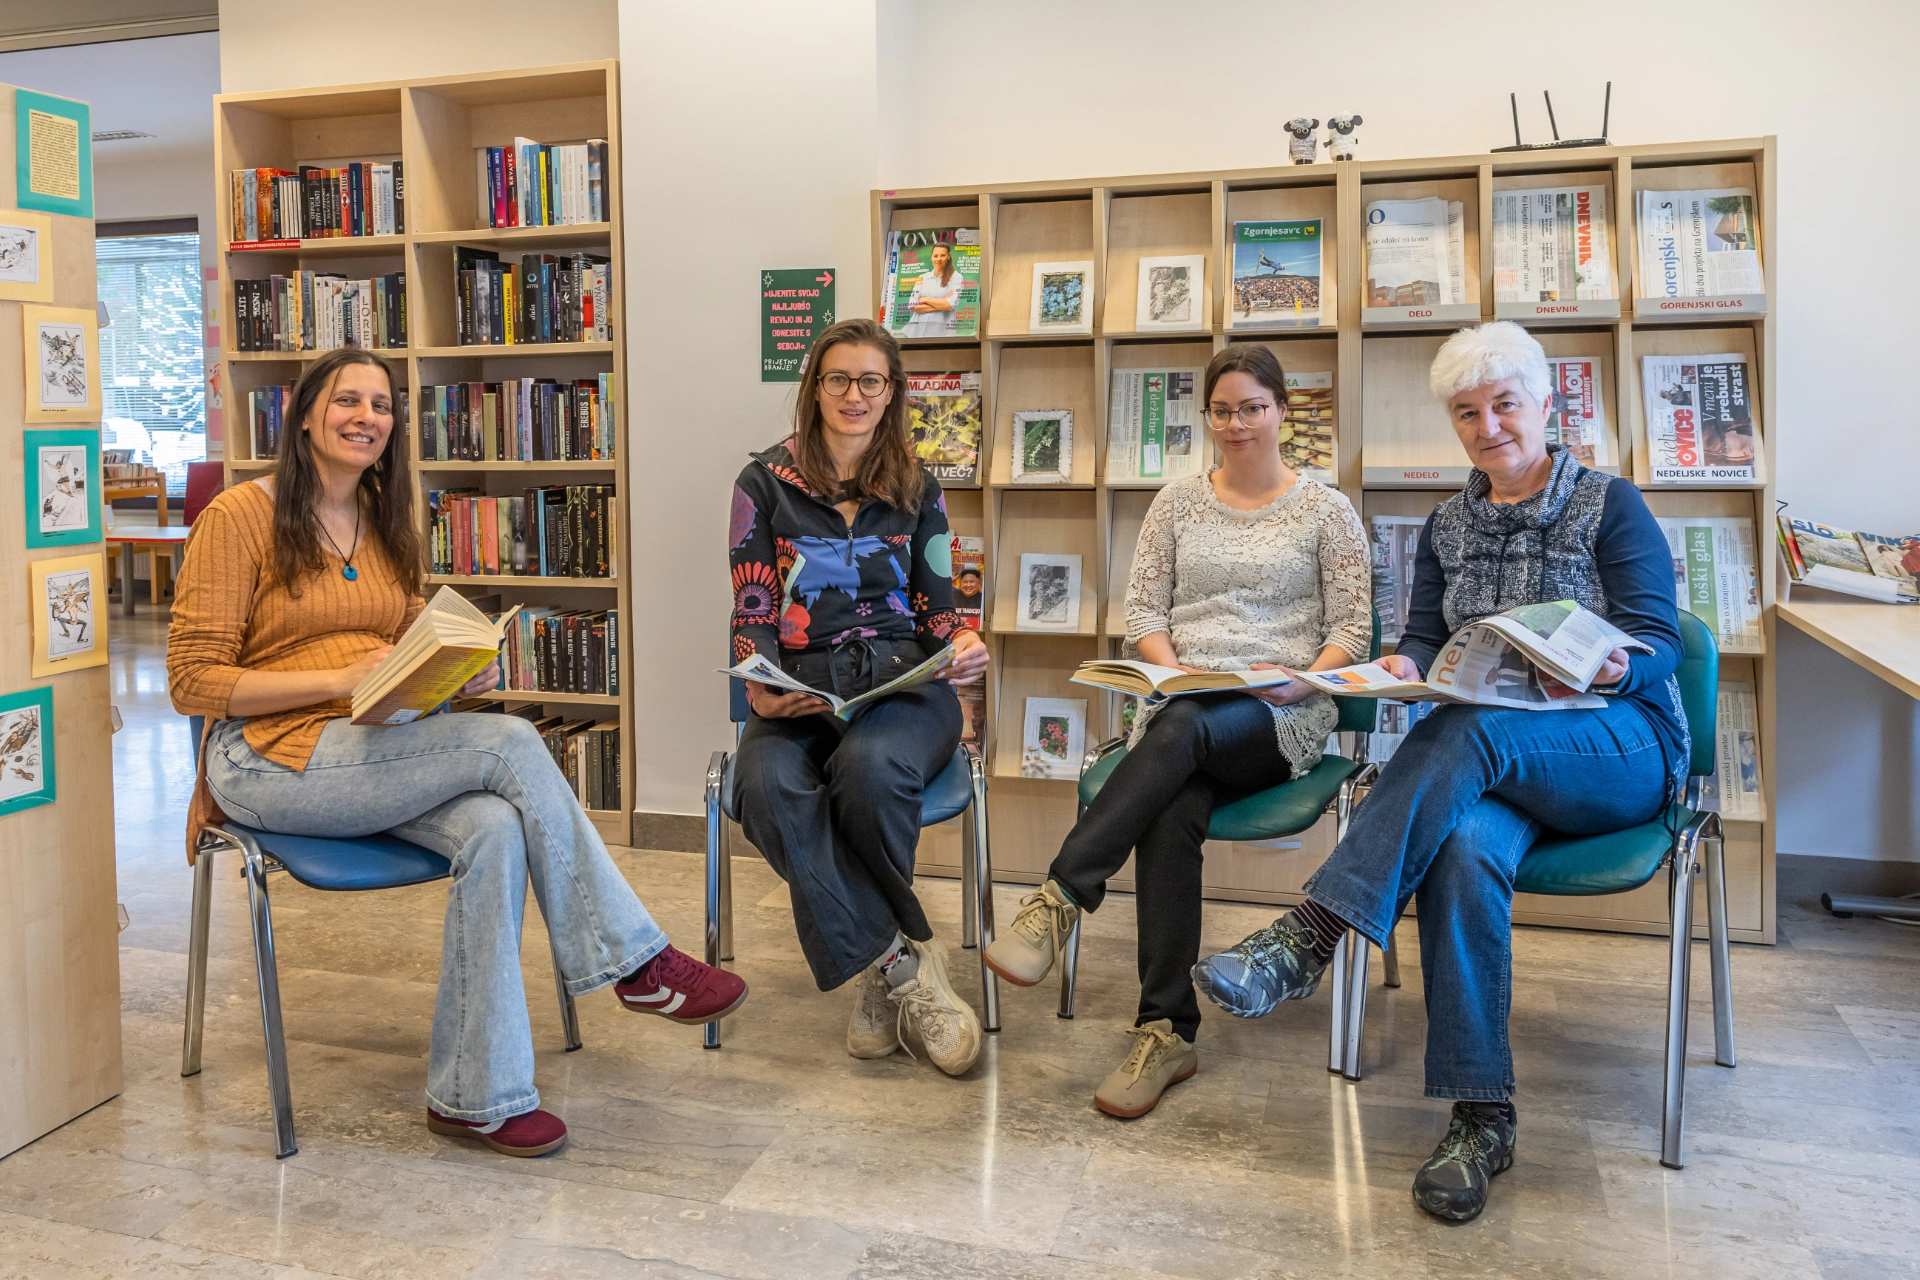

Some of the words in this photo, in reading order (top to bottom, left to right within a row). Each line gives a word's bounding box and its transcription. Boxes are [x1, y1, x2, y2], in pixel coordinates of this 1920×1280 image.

[1576, 191, 1592, 266] DNEVNIK
[798, 289, 820, 297] SVOJO
[772, 301, 811, 311] NAJLJUBŠO
[1408, 309, 1433, 318] DELO
[1536, 305, 1579, 314] DNEVNIK
[1660, 300, 1714, 310] GORENJSKI
[1716, 299, 1743, 308] GLAS
[361, 296, 371, 341] LORE
[770, 316, 794, 324] REVIJO
[795, 316, 803, 324] IN
[804, 316, 813, 324] JO
[772, 329, 805, 337] ODNESITE
[805, 329, 811, 337] S
[1700, 365, 1714, 379] je
[907, 380, 962, 391] MLADINA
[1284, 378, 1299, 387] KA
[1729, 364, 1744, 406] strast
[1583, 376, 1593, 413] slovenske
[1700, 381, 1715, 411] meni
[1713, 365, 1733, 422] prebudil
[579, 401, 589, 428] EREBOS
[1148, 393, 1161, 434] deželne
[1702, 412, 1716, 422] V
[1673, 408, 1698, 467] ovice
[941, 464, 974, 478] VEČ?
[1403, 471, 1440, 479] NEDELO
[1656, 469, 1706, 478] NEDELJSKE
[1711, 469, 1748, 478] NOVICE
[1690, 531, 1711, 562] glas
[1692, 567, 1710, 605] loški
[1719, 572, 1730, 610] vztrajnosti
[1723, 618, 1734, 646] Zgodba
[1721, 733, 1732, 760] prostor
